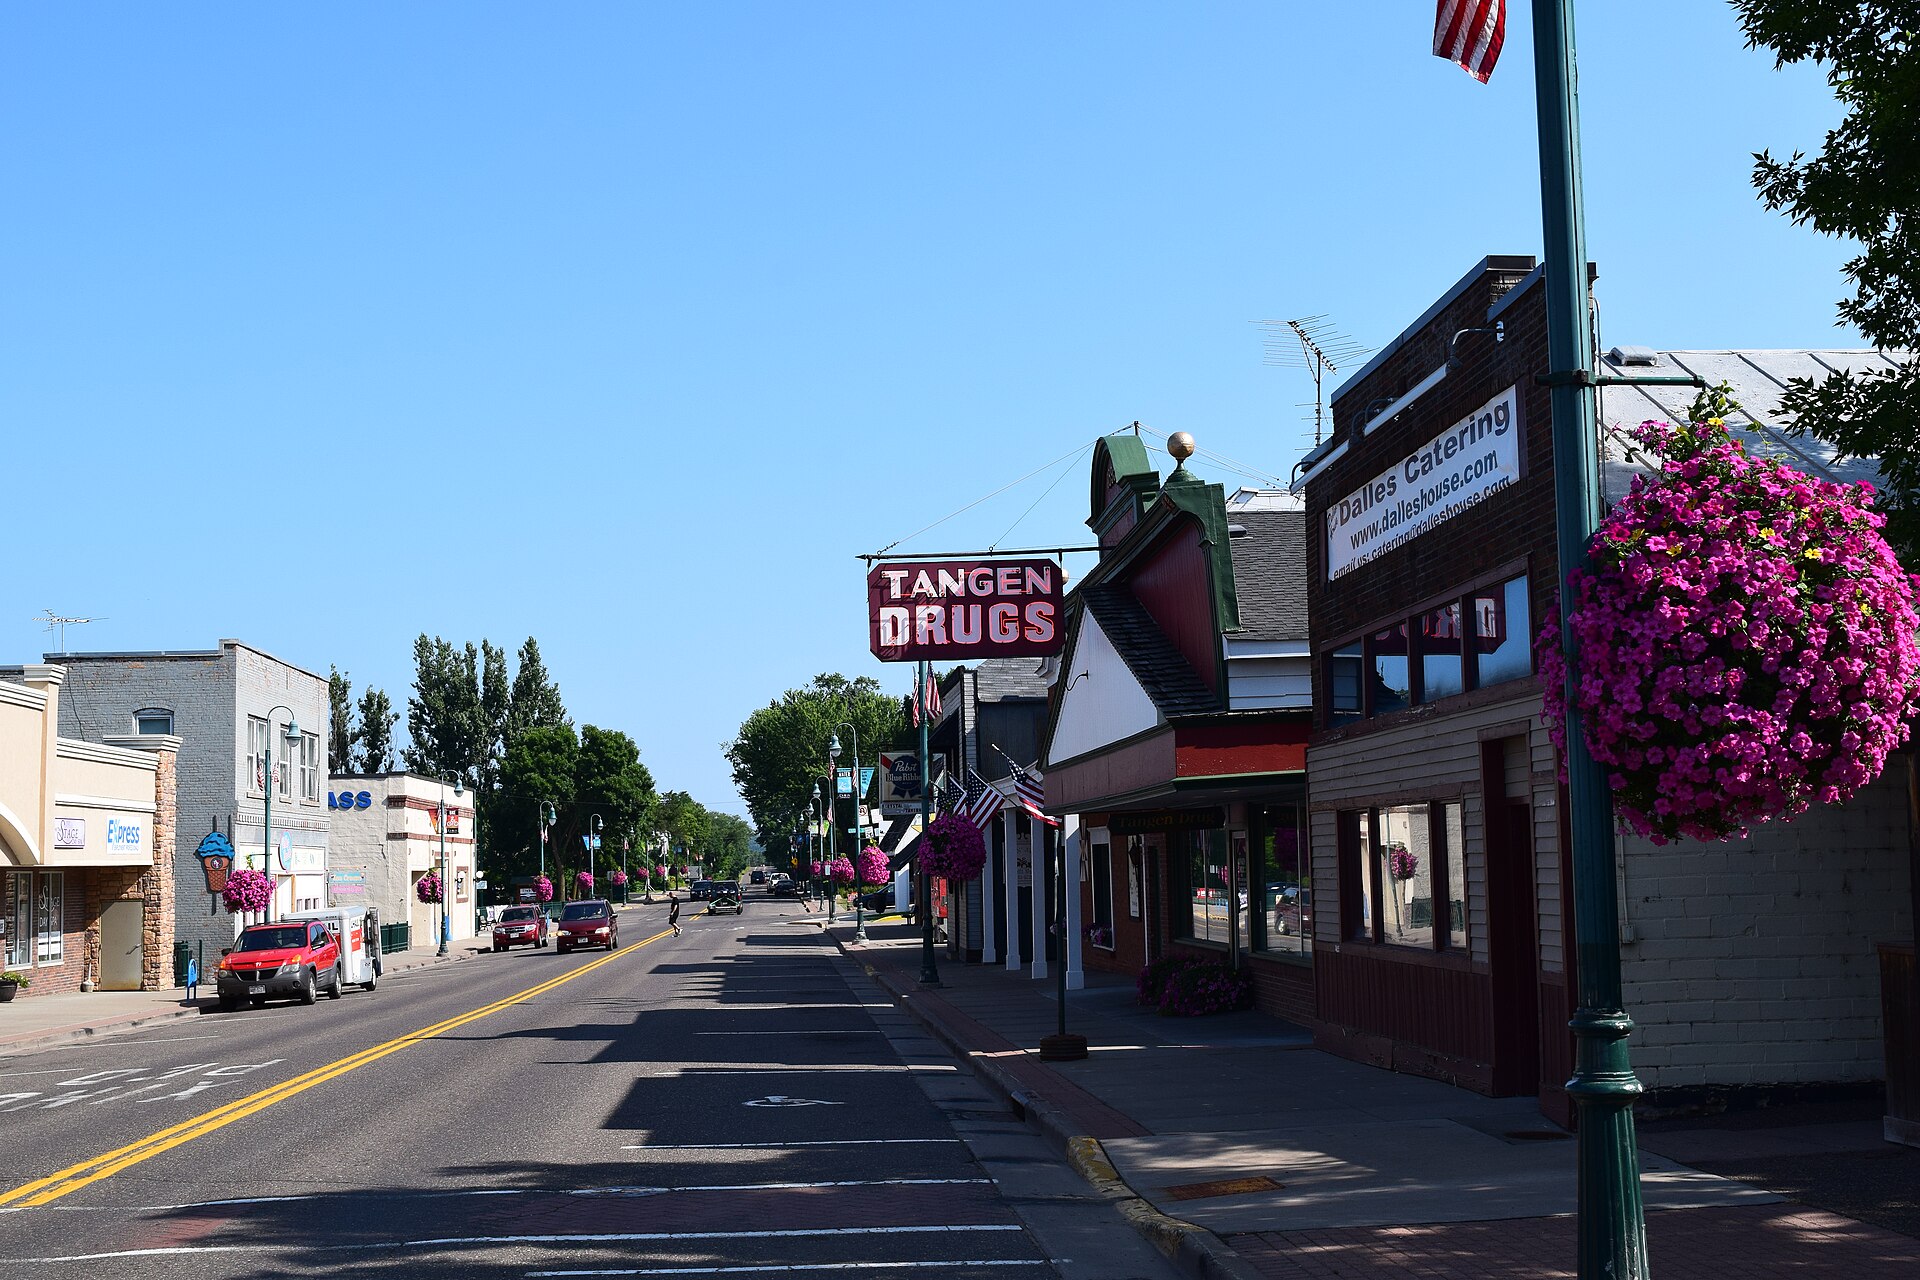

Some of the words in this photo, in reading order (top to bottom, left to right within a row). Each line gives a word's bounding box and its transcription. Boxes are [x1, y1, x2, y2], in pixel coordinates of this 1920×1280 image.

[1339, 475, 1396, 526] Dalles
[1404, 401, 1510, 484] Catering
[1350, 450, 1498, 550] www.dalleshouse.com
[881, 565, 1053, 599] TANGEN
[878, 602, 1056, 647] DRUGS
[886, 773, 902, 782] Blue
[903, 773, 922, 781] Ribb
[894, 760, 917, 772] Pabst
[1118, 814, 1174, 828] Tangen
[1178, 812, 1216, 825] Drug
